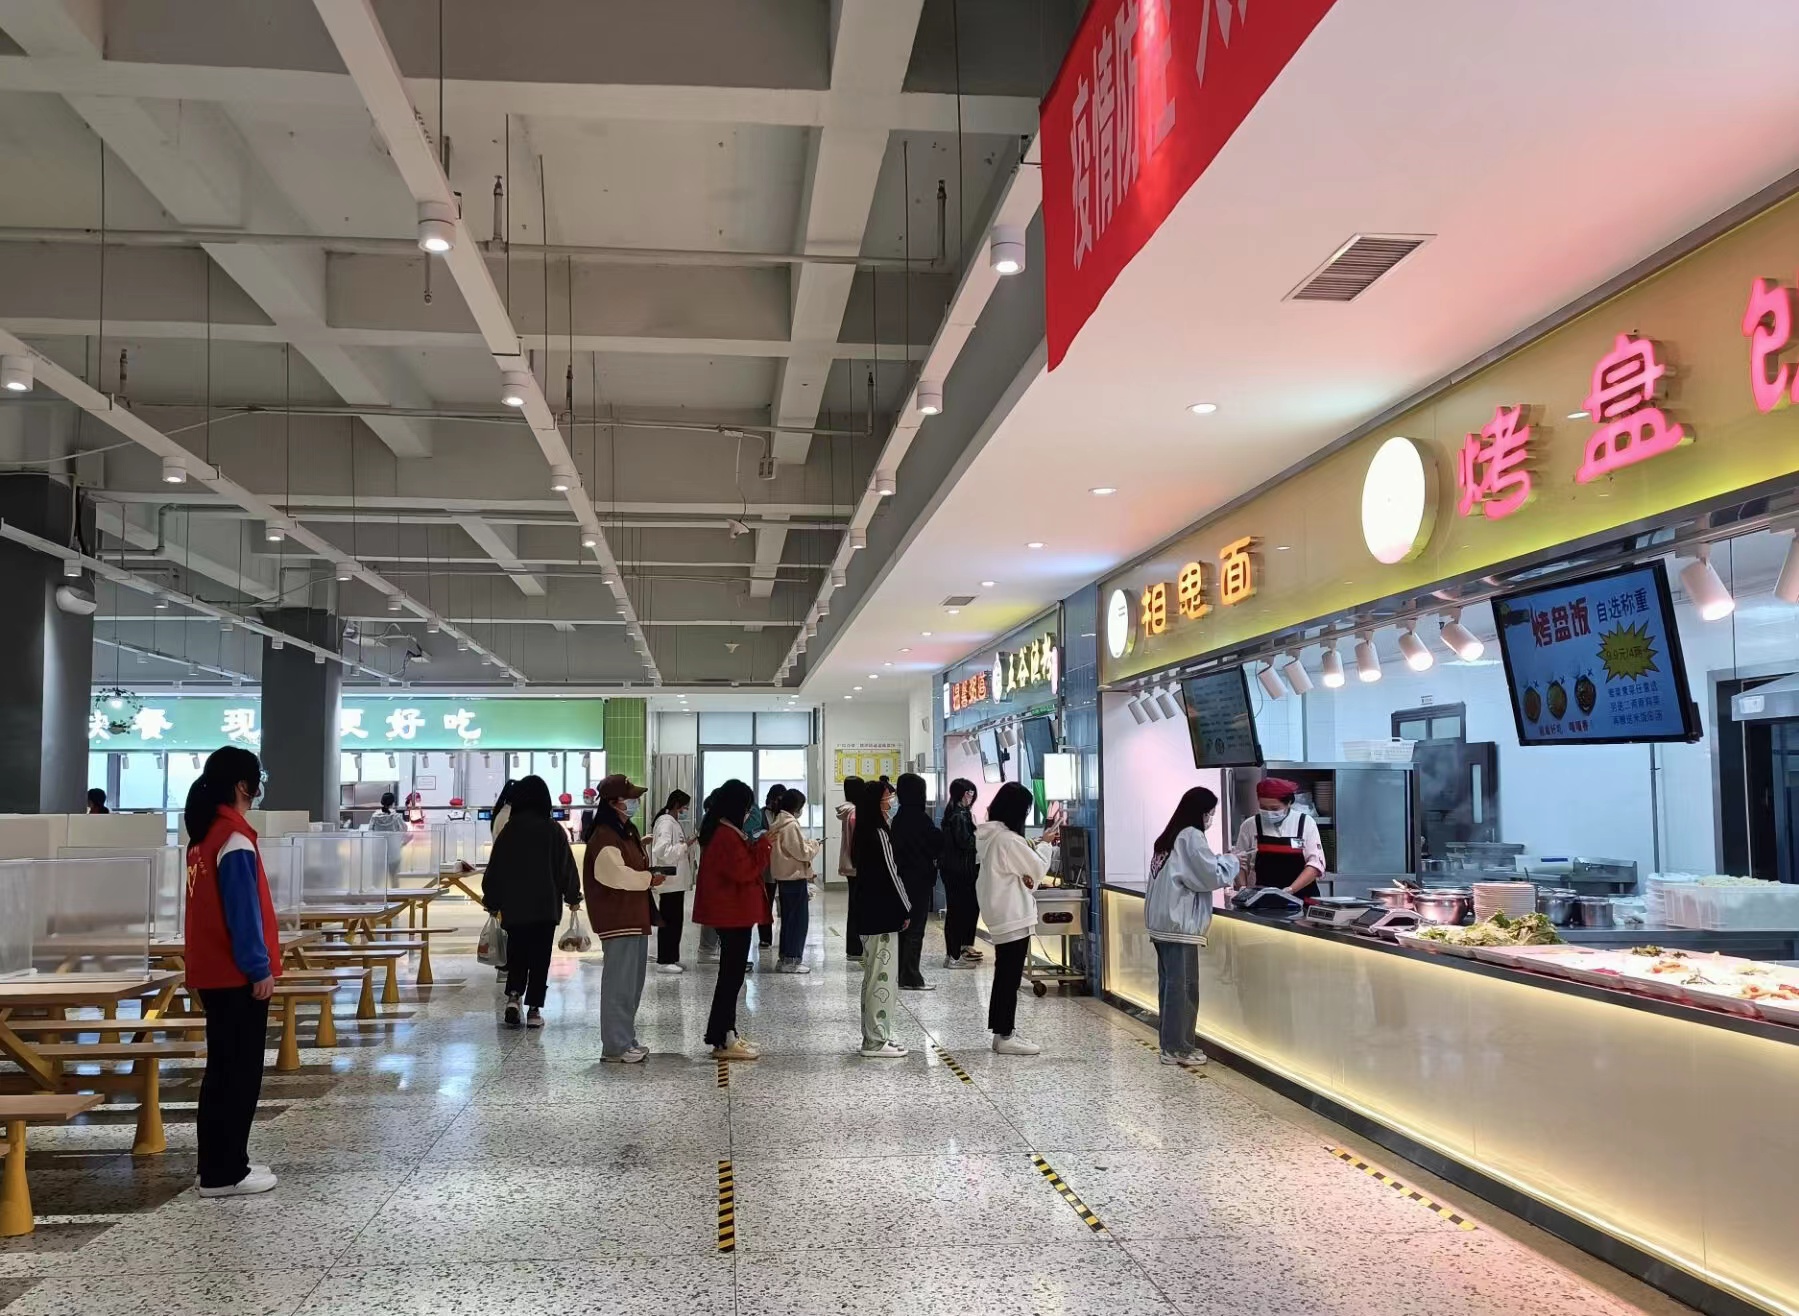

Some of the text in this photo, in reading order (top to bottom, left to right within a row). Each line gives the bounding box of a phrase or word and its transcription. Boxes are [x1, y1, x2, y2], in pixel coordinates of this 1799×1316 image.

[1141, 535, 1253, 638] 相思面
[1531, 588, 1650, 648] 烤盘饭 自选称重
